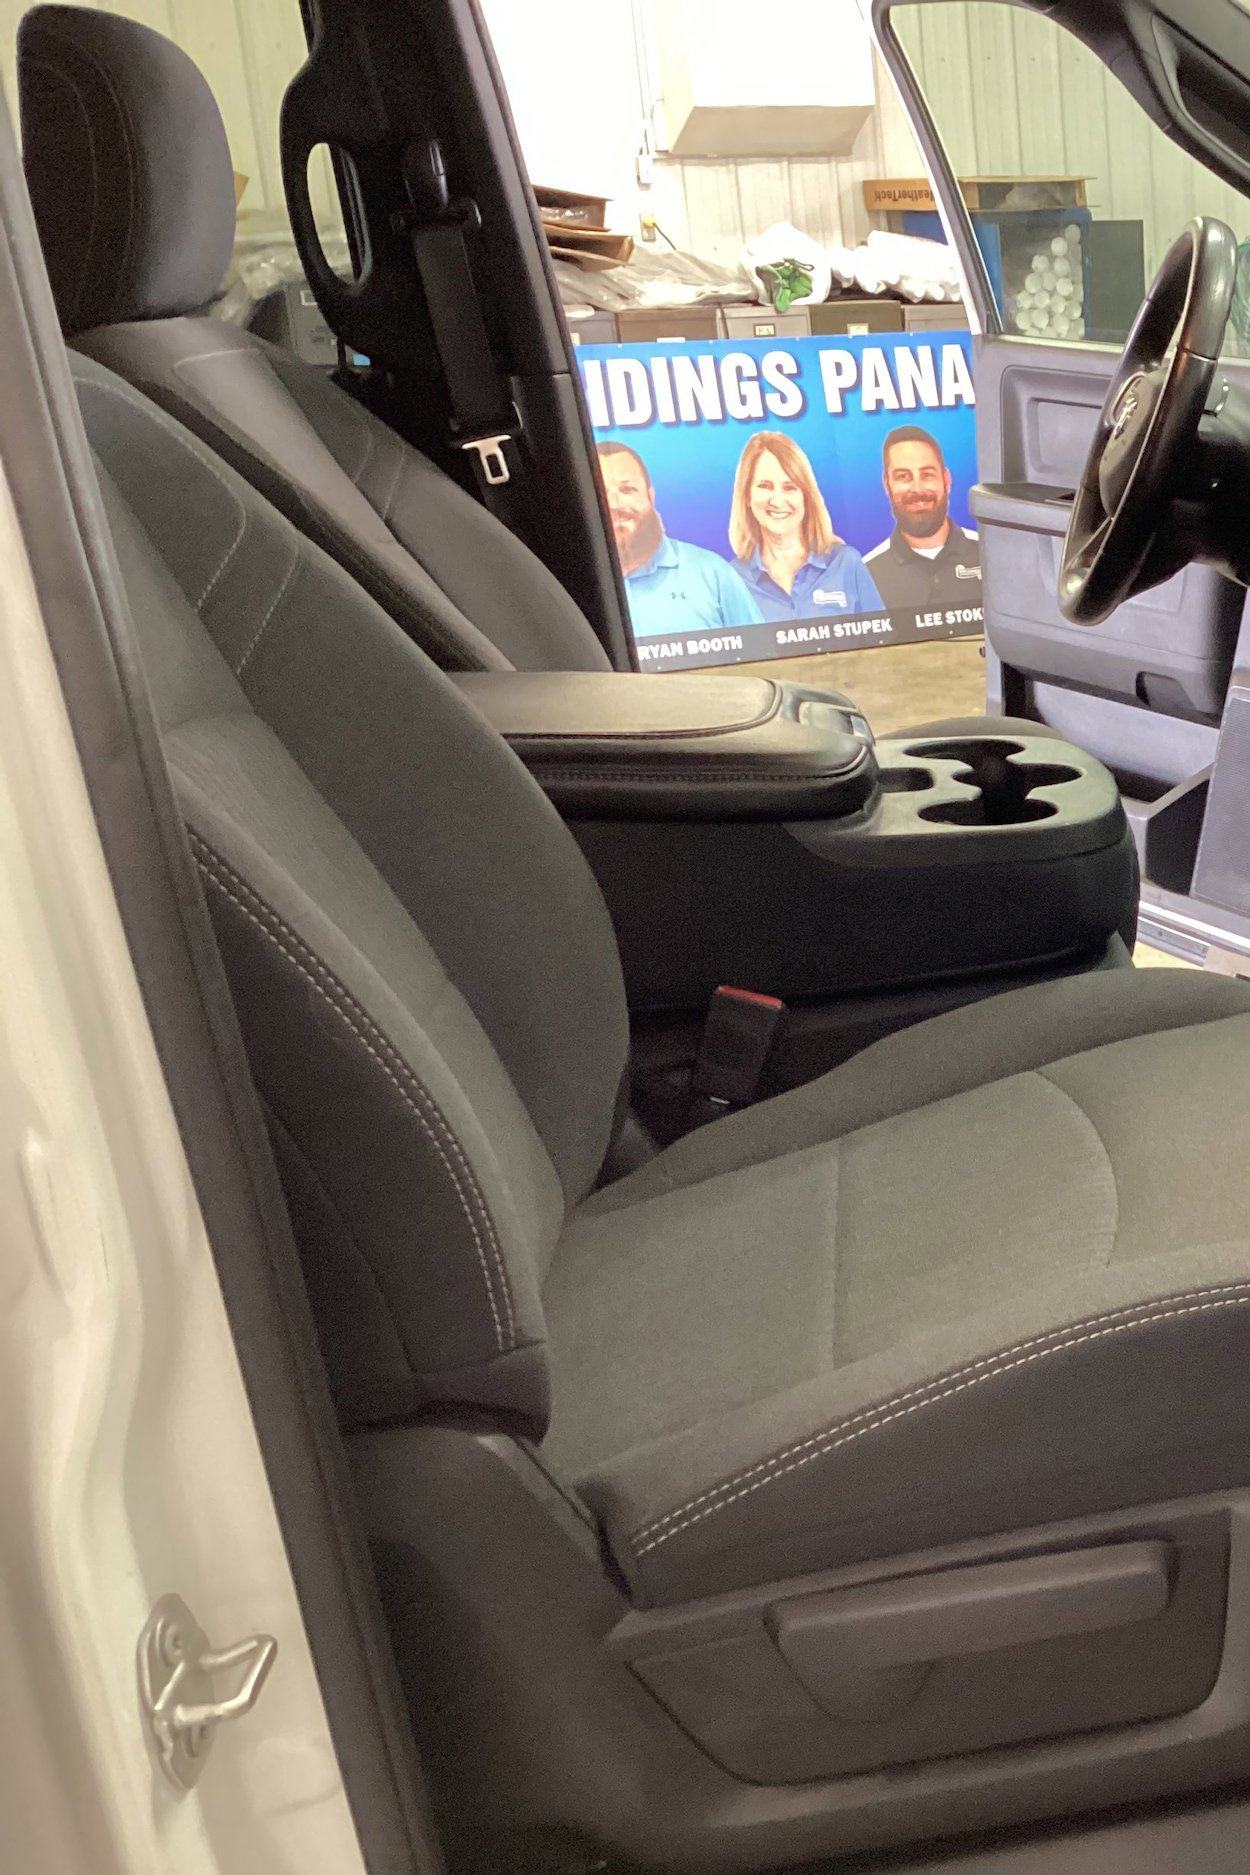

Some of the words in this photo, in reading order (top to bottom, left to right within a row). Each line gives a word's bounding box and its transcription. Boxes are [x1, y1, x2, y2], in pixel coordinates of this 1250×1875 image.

[818, 344, 976, 413] PANA
[915, 612, 943, 628] LEE
[945, 607, 984, 625] STOK
[776, 625, 830, 645] SARAH
[834, 618, 892, 638] STUPEK
[637, 642, 684, 661] RYAN
[687, 635, 743, 655] BOOTH
